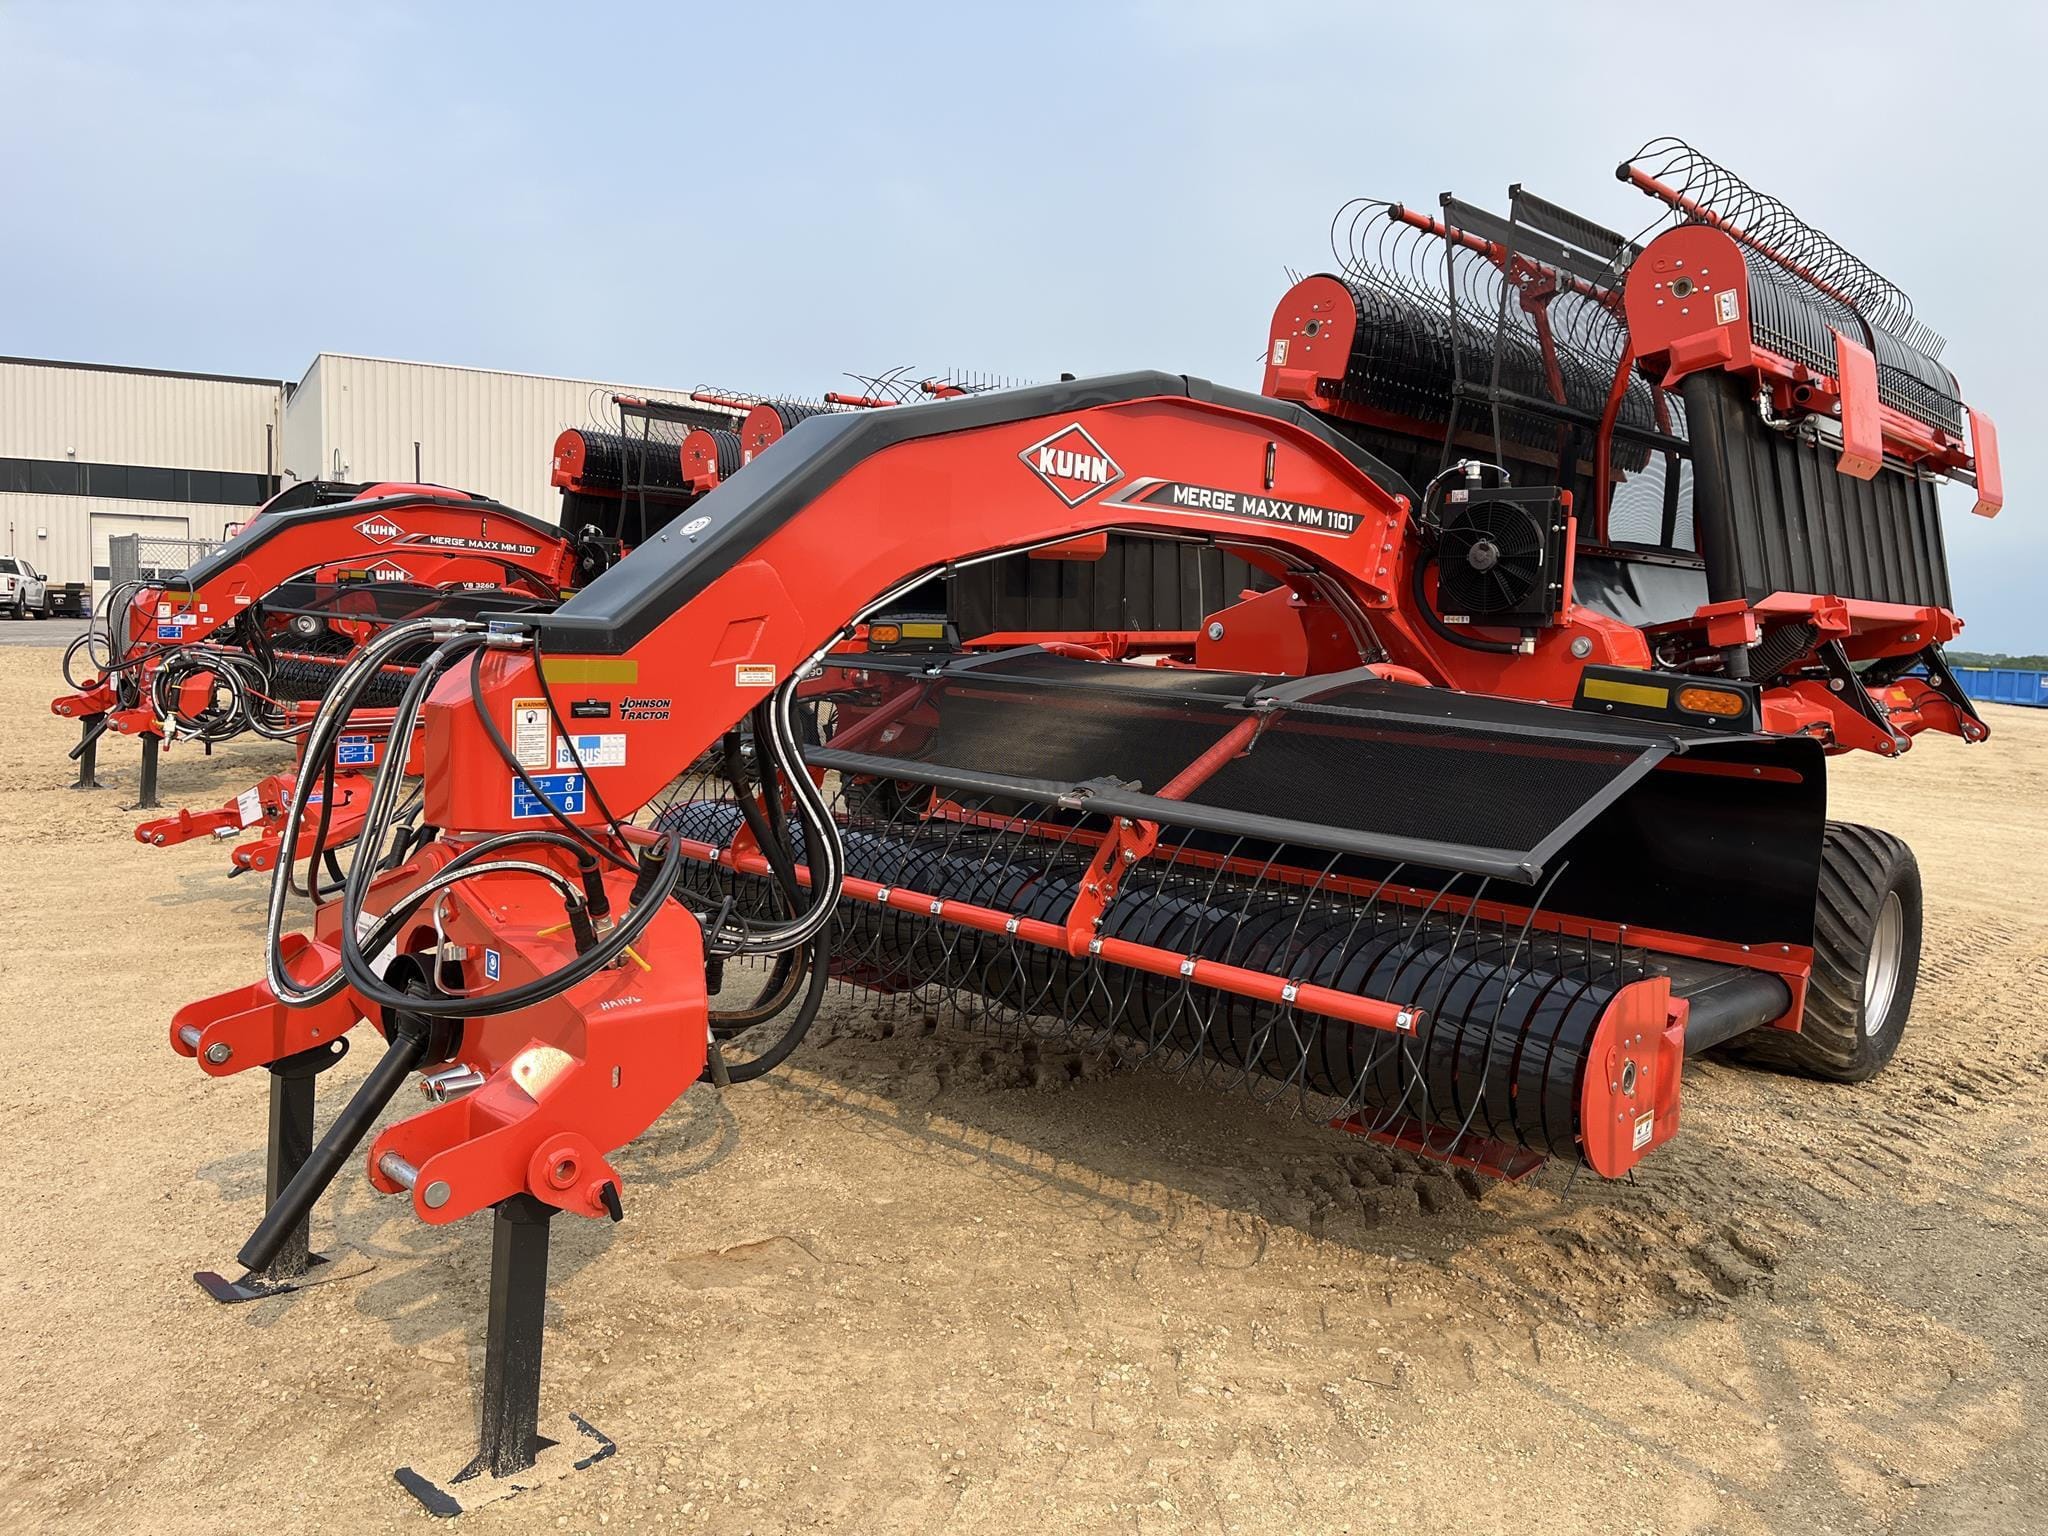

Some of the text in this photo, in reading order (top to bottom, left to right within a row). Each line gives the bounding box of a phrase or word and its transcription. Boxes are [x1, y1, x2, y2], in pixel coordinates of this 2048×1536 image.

[1039, 446, 1108, 484] KUHN
[1173, 485, 1354, 531] MERGE MAXX MM 1101
[362, 523, 397, 537] KUHN
[430, 535, 536, 554] MERGE MAXX MM 1101
[375, 570, 405, 581] UHN
[619, 696, 671, 709] JOHNSON
[620, 709, 670, 720] TRACTOR
